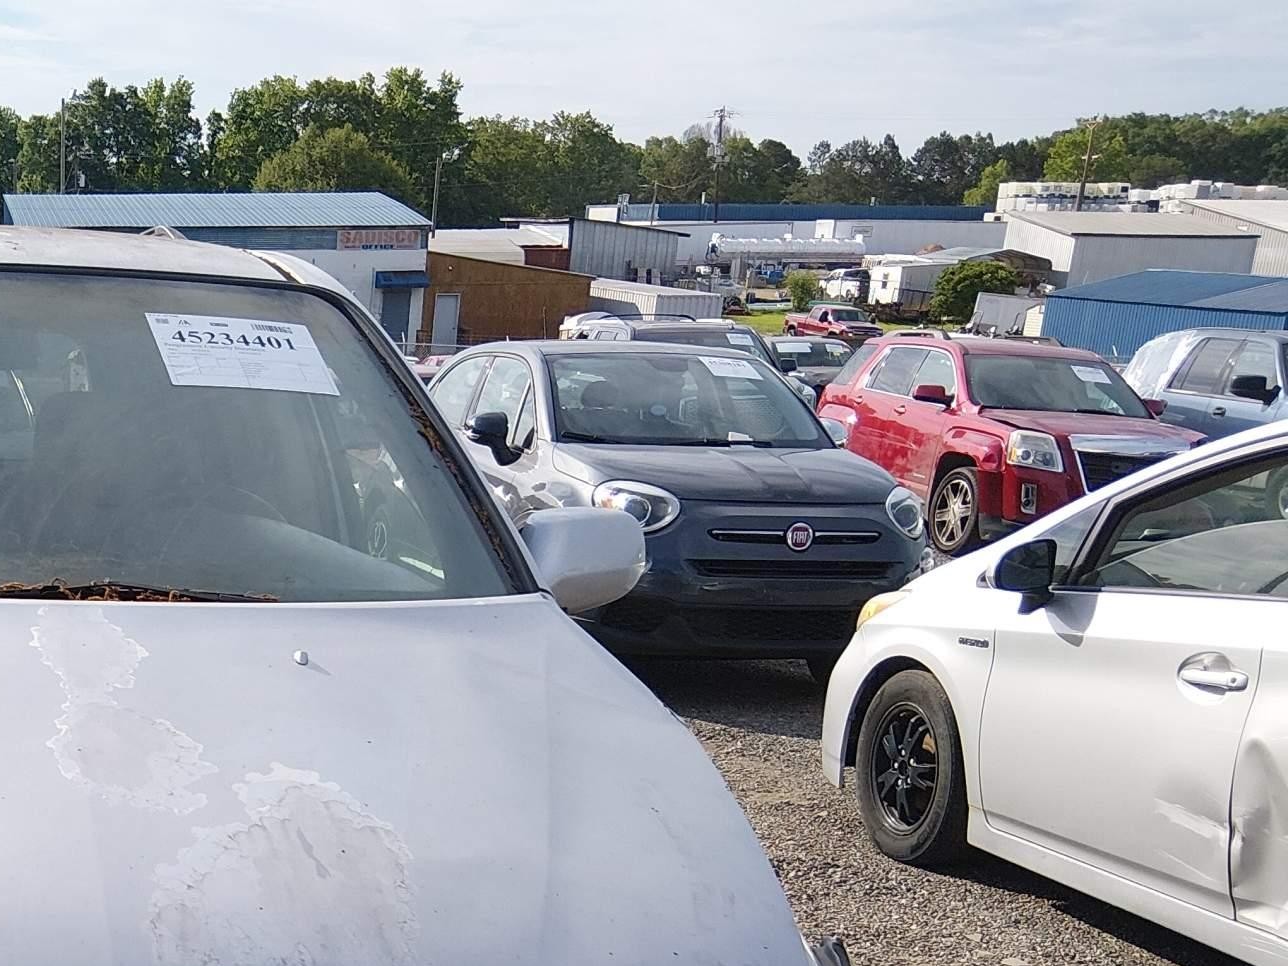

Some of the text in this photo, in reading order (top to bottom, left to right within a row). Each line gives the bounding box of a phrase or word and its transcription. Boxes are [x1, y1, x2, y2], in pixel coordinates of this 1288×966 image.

[341, 231, 419, 244] SADISCO
[171, 329, 297, 351] 45234401
[792, 531, 808, 544] FIAT
